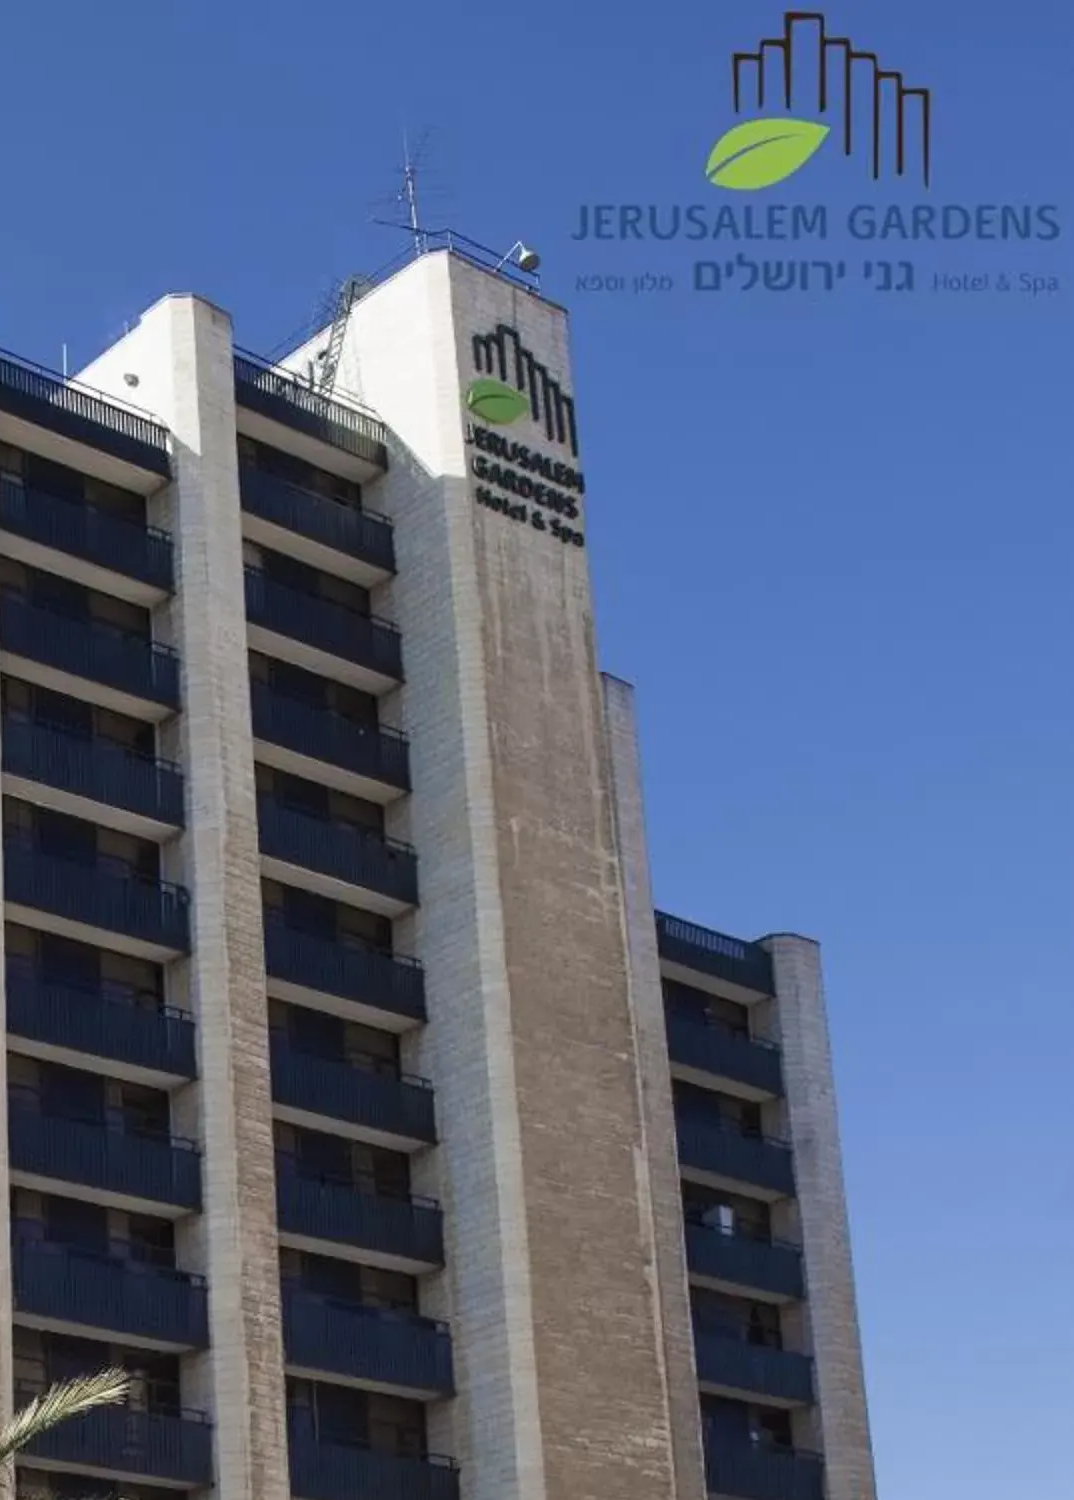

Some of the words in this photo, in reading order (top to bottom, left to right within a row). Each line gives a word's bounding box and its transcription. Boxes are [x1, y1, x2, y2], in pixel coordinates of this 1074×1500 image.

[466, 421, 585, 494] JERUSALEM
[472, 456, 579, 519] GARDENS
[476, 485, 527, 522] Hotel
[531, 510, 547, 530] &
[550, 518, 585, 548] Spa
